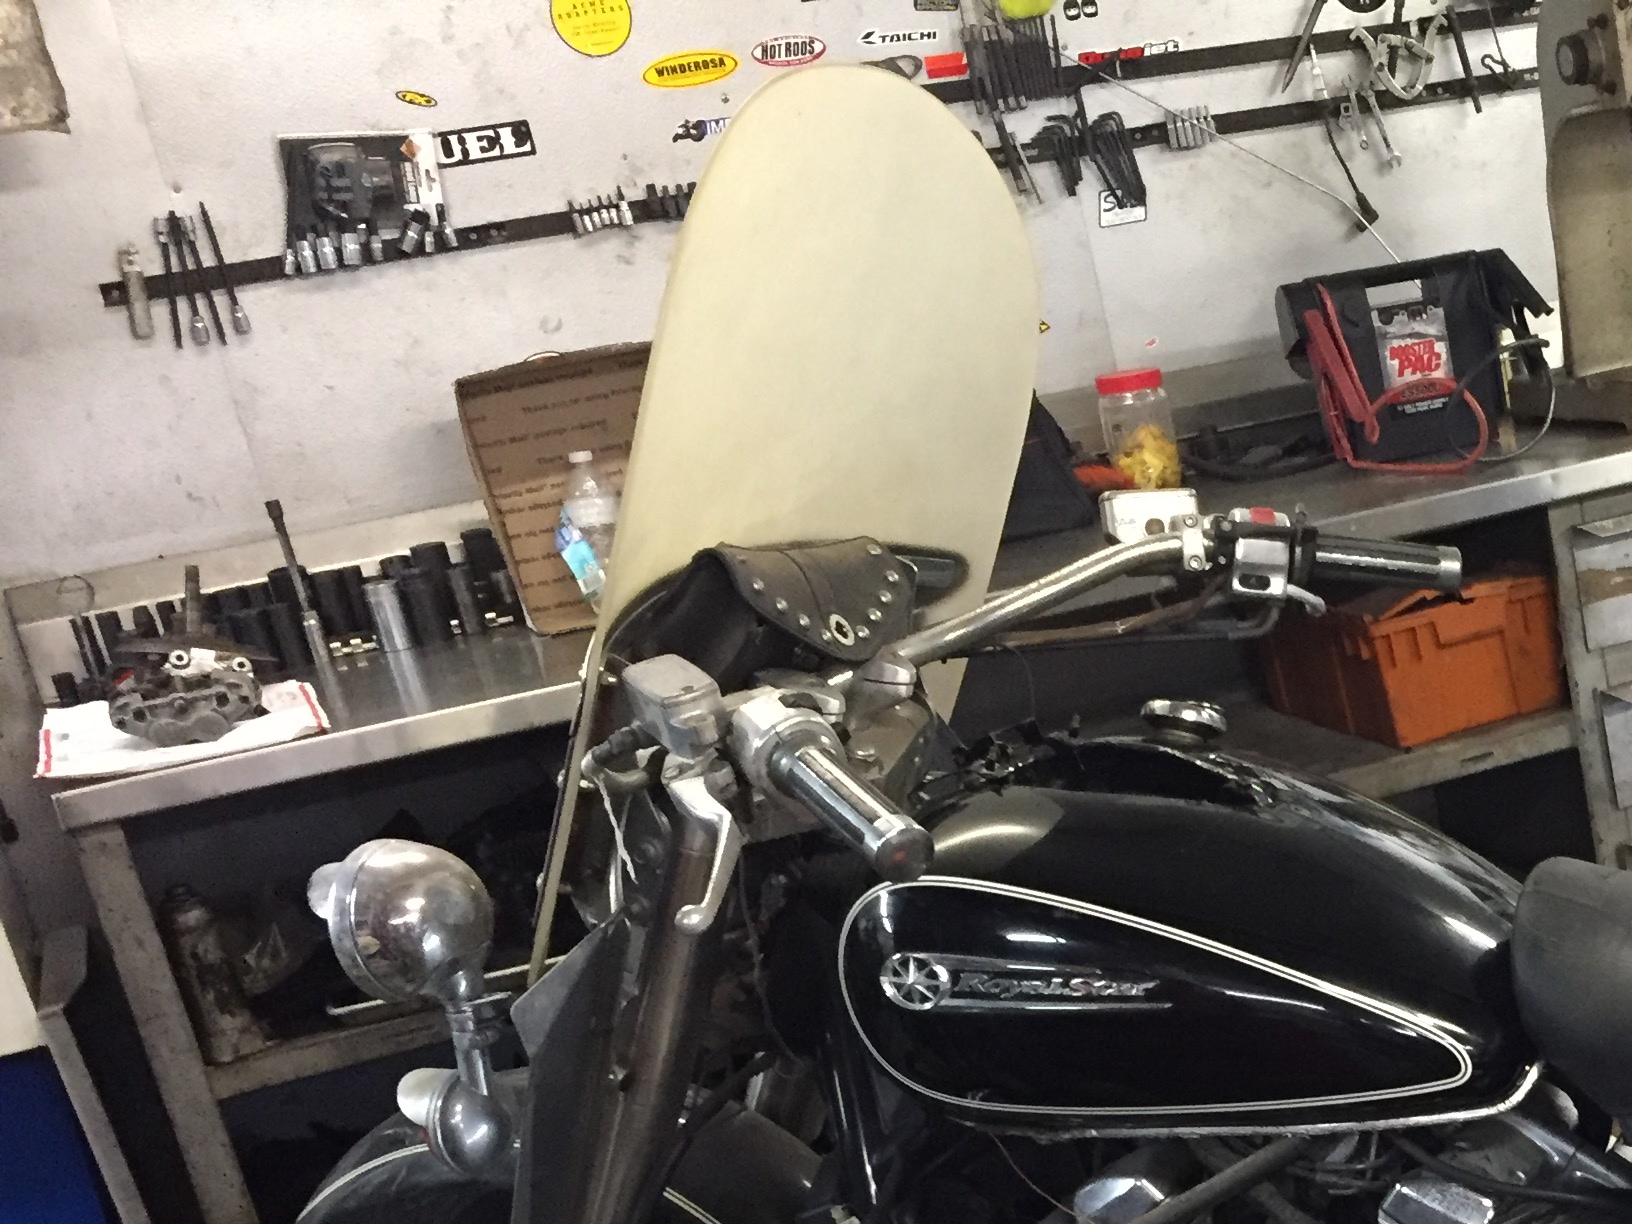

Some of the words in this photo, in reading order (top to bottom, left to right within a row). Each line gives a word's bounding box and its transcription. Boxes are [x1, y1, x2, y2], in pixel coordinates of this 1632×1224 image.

[878, 31, 937, 44] TAICHI
[761, 43, 783, 61] HOT
[784, 39, 816, 58] RODS
[654, 57, 727, 78] WINDEROSA
[1397, 352, 1442, 378] PAC
